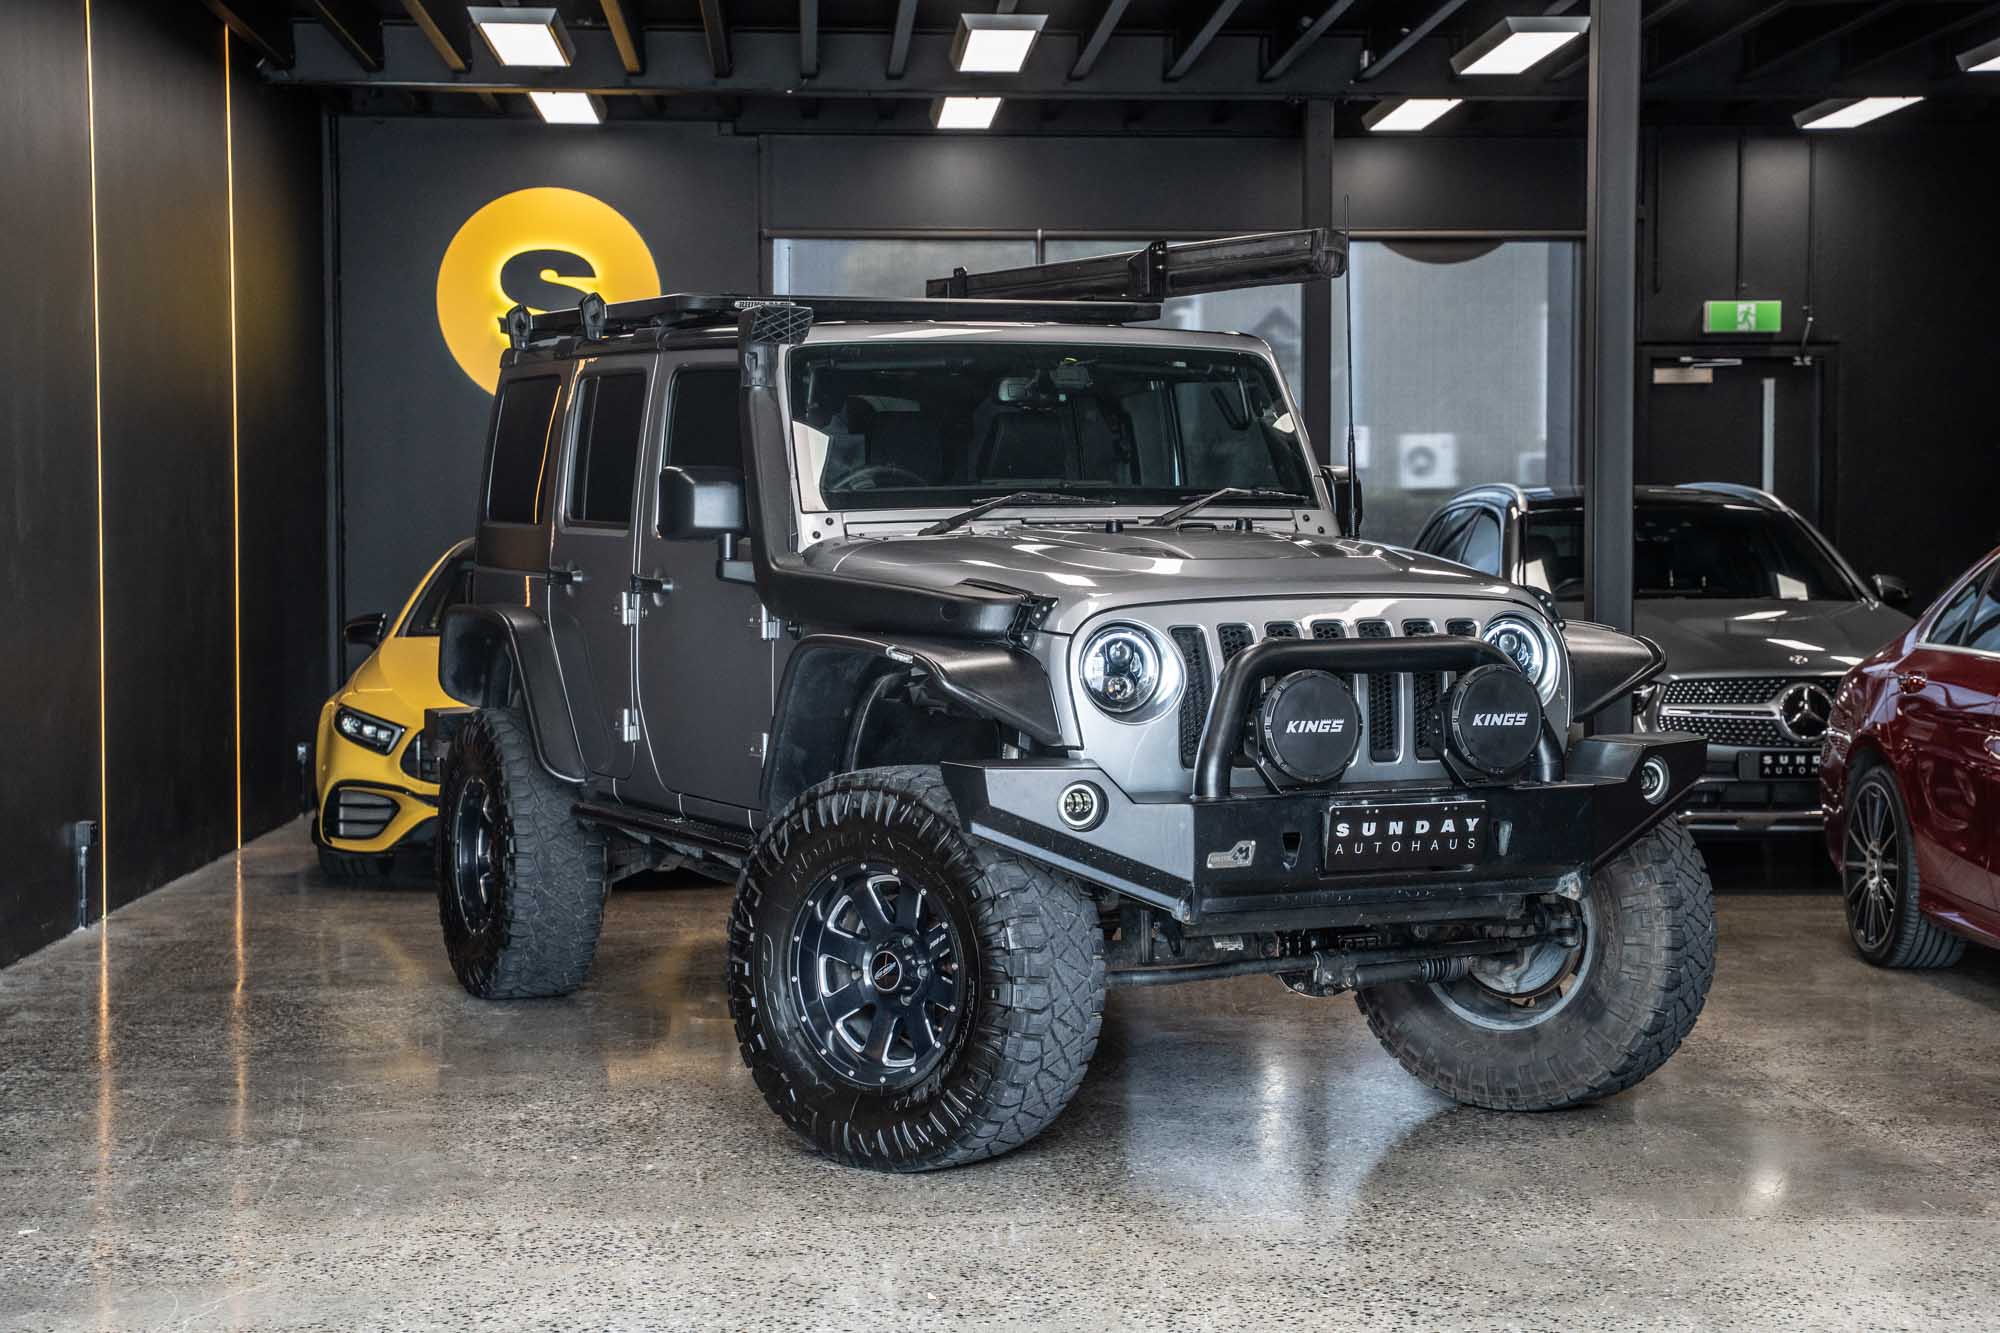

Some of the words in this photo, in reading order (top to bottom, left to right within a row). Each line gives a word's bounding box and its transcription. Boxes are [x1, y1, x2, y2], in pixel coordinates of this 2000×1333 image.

[1285, 718, 1345, 733] KINGS
[1472, 711, 1529, 727] KINGS
[1763, 755, 1821, 765] SUND
[1764, 766, 1818, 775] AUTOH
[1336, 817, 1480, 838] SUNDAY
[1335, 838, 1476, 856] AUTOHAUS
